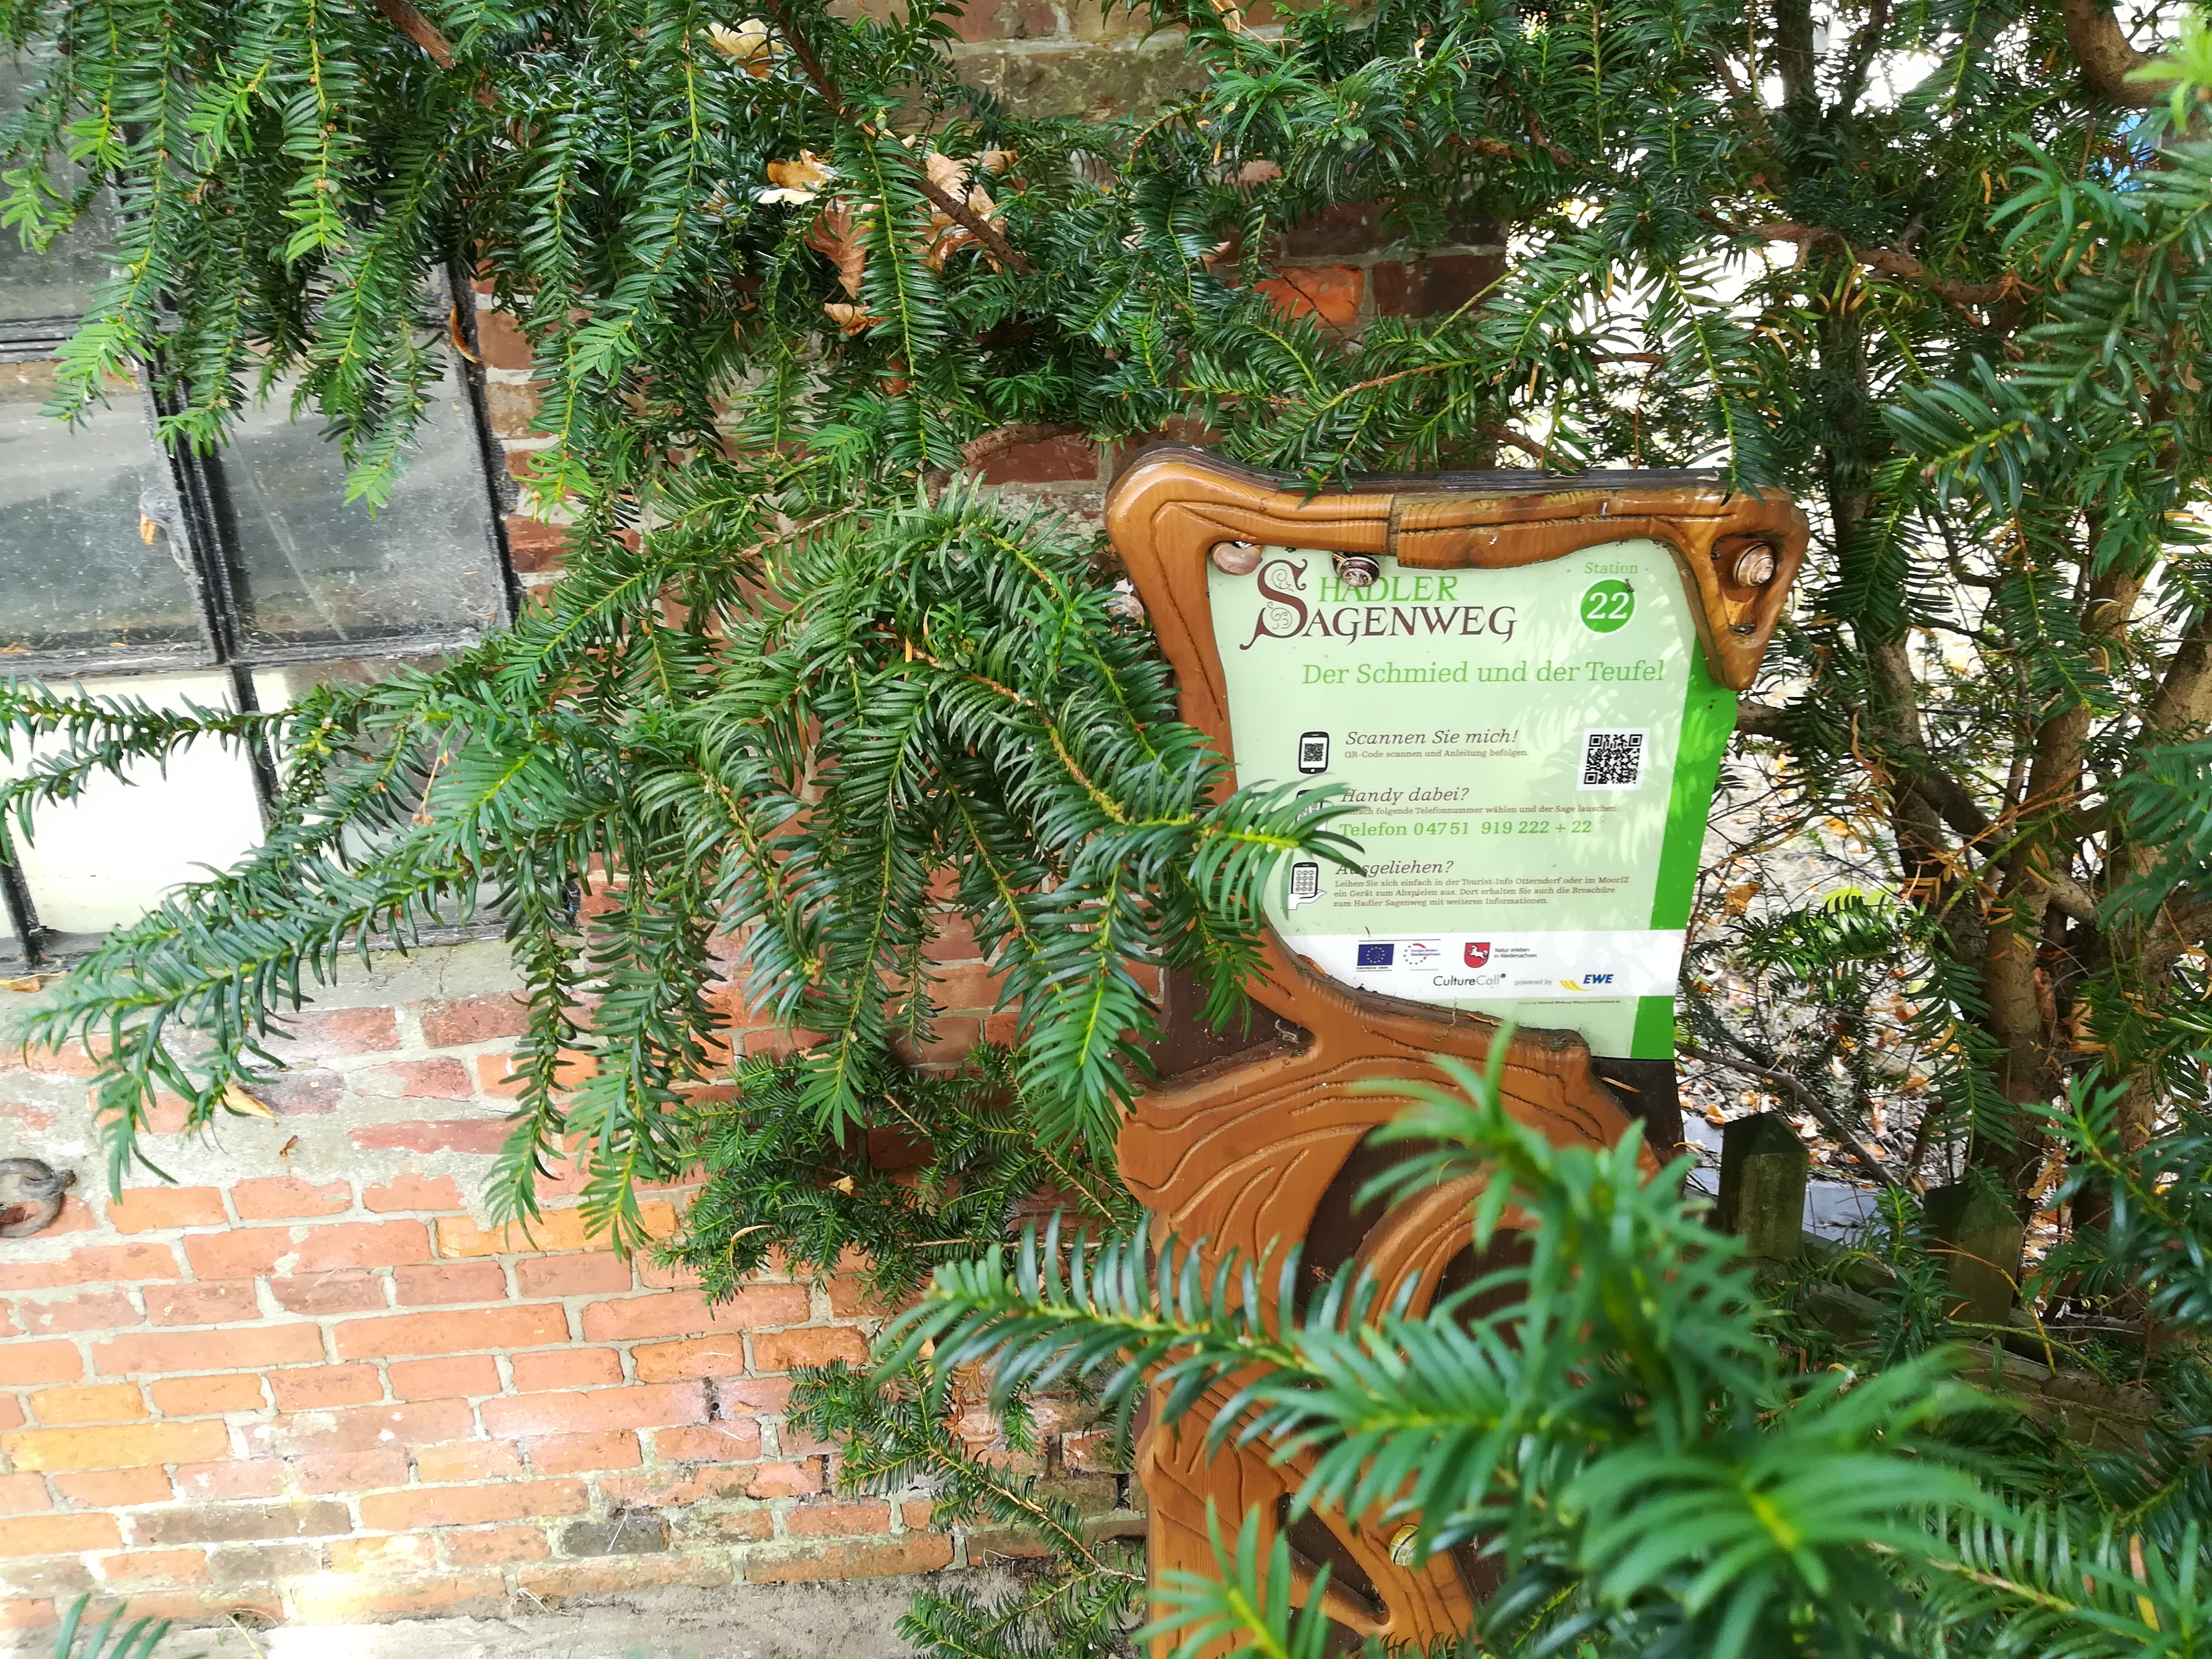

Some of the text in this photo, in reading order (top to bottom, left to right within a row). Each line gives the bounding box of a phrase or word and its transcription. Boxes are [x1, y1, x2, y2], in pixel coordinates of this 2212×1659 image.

[1584, 562, 1638, 574] Station
[1239, 559, 1519, 650] SAGENWEG
[1587, 592, 1629, 619] 22
[1301, 659, 1665, 684] Der Schmied und der Teufel
[1346, 729, 1519, 745] Scannen Sie mich!
[1444, 749, 1487, 759] Anleitung
[1490, 749, 1529, 758] befolgen.
[1341, 787, 1469, 805] Handy dabei?
[1376, 807, 1413, 816] folgende
[1555, 806, 1575, 814] Sage
[1340, 822, 1408, 836] Telefon
[1481, 821, 1512, 835] 919
[1517, 821, 1549, 833] 222
[1555, 823, 1565, 833] +
[1571, 821, 1592, 833] 22
[1395, 889, 1437, 897] Abspielen
[1385, 899, 1427, 908] Sagenweg
[1583, 974, 1613, 984] EWE
